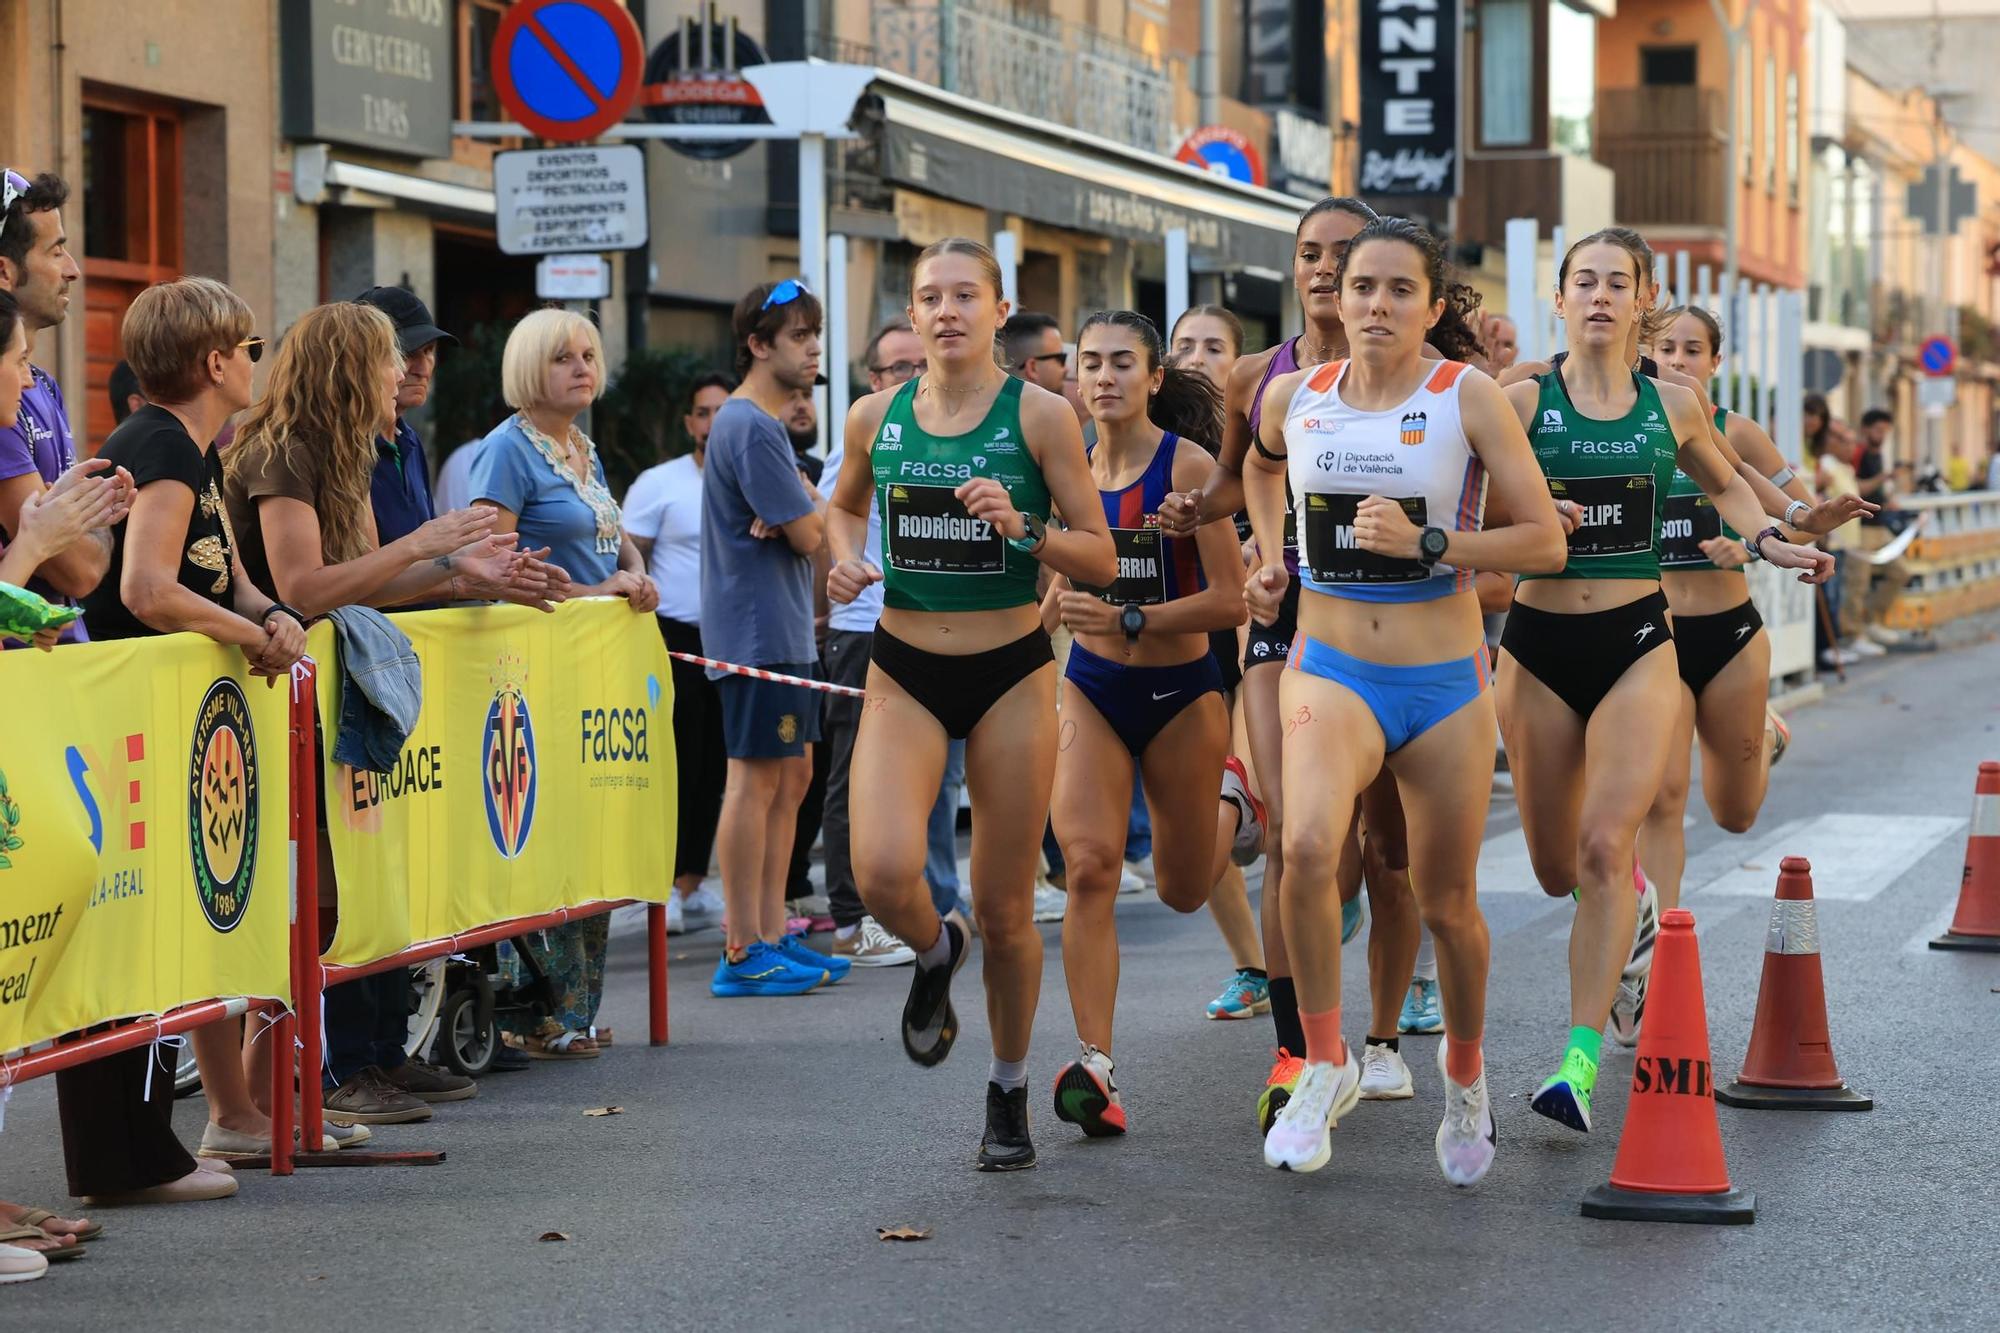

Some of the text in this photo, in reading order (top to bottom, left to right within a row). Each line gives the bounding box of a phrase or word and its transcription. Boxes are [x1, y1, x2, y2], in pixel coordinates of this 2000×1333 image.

[1377, 0, 1438, 135] NTE
[537, 153, 598, 167] EVENTOS
[527, 168, 609, 182] DEPORTIVOS
[1571, 440, 1638, 454] Facsa
[1345, 452, 1394, 464] Diputació
[900, 461, 972, 479] Facsa
[1344, 464, 1403, 475] de València
[898, 512, 992, 541] RODRÍGUEZ
[1132, 533, 1140, 544] 4
[1117, 556, 1158, 579] RRIA
[582, 707, 649, 764] Facsa
[191, 693, 255, 798] ATLETISME VILA-REAL
[214, 890, 236, 916] 1986
